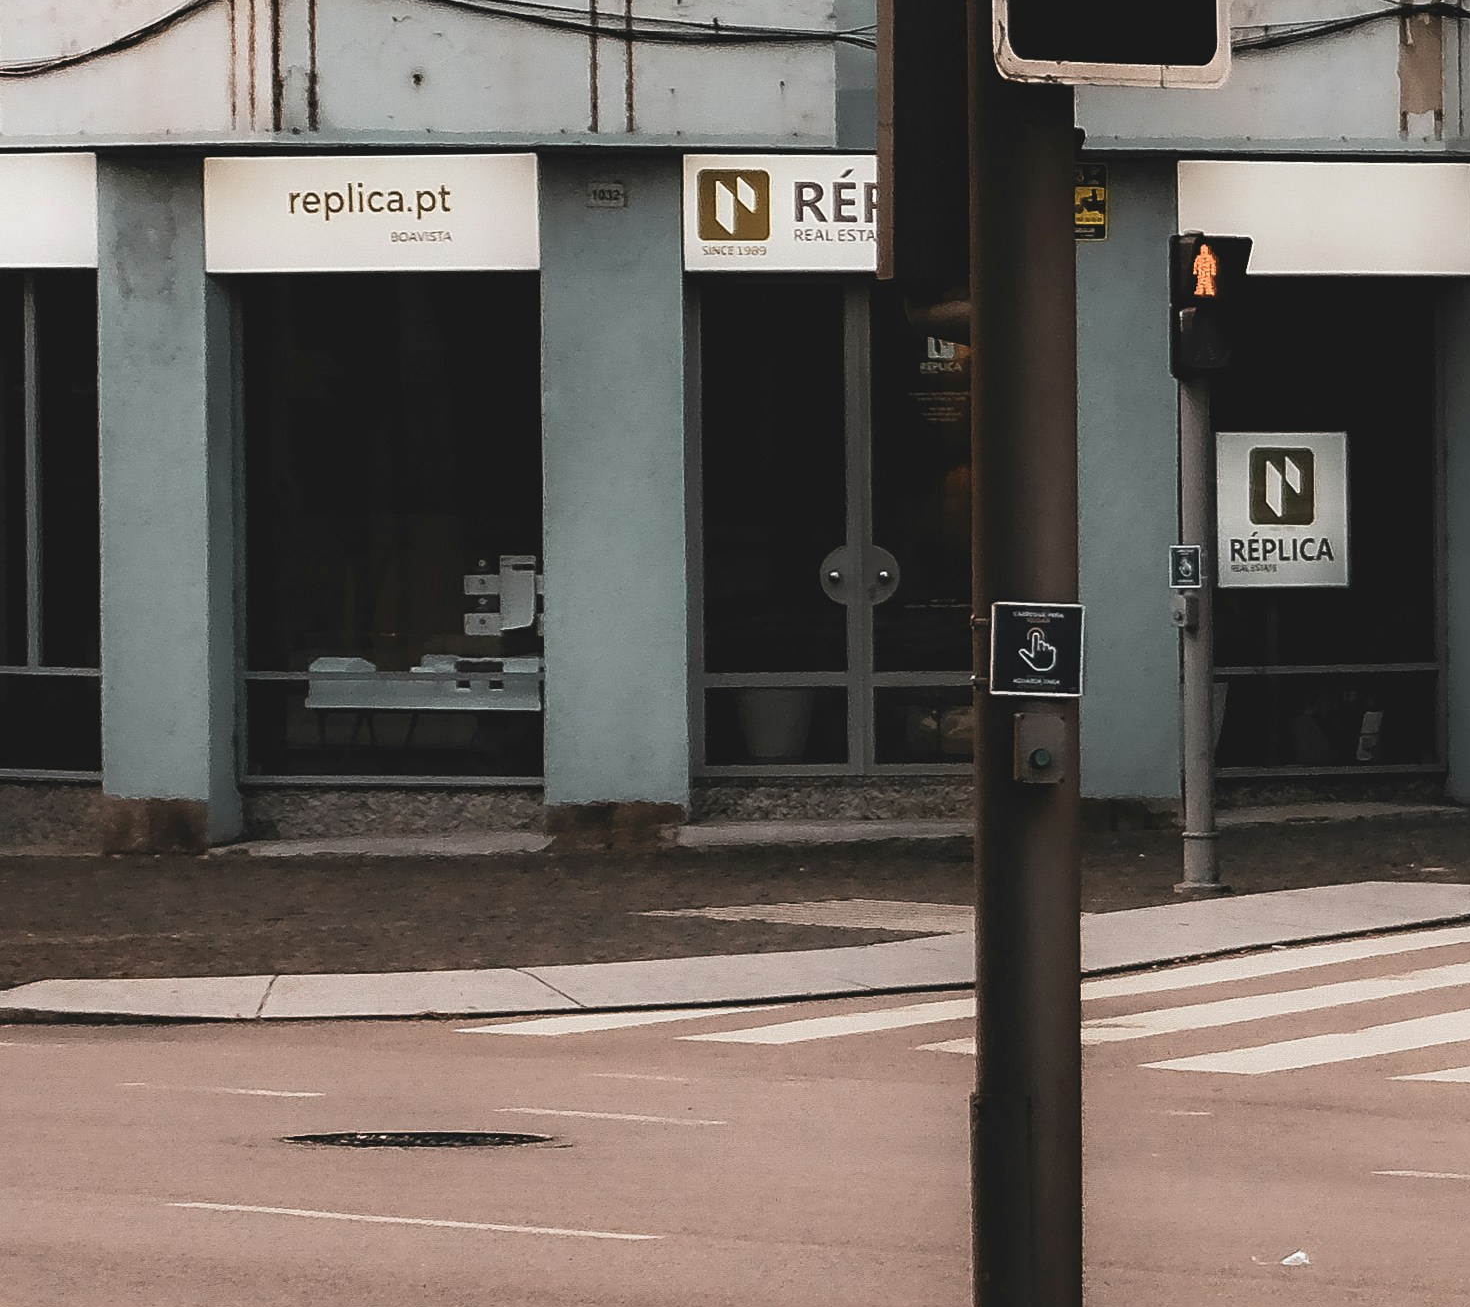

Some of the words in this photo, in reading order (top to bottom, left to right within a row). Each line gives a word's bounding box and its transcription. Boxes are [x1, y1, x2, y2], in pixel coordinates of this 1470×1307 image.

[288, 182, 452, 221] replica.pt
[390, 231, 453, 243] BOAVISTA
[794, 229, 833, 242] REAL
[702, 246, 734, 256] SINCE
[738, 246, 767, 256] 1989
[1230, 531, 1335, 562] RÉPLICA
